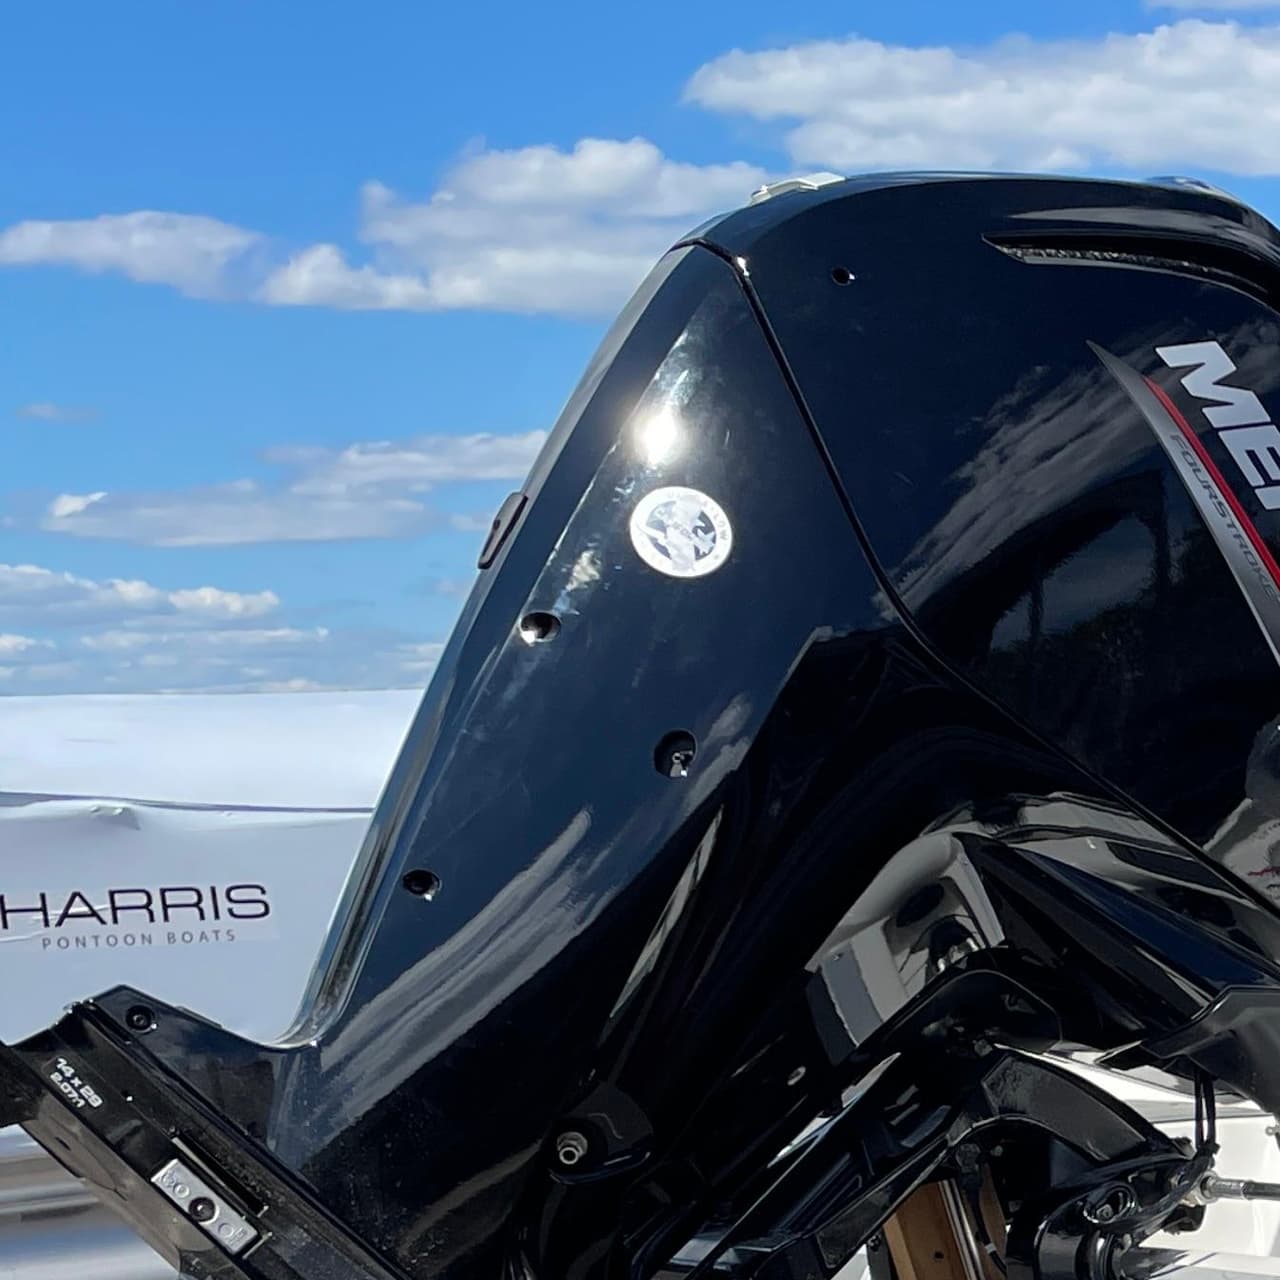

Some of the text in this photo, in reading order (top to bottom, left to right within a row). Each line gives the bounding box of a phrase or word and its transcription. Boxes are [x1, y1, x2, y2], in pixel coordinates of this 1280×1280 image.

[1170, 434, 1278, 600] FOURSTROKE
[0, 884, 271, 930] HARRIS
[42, 929, 236, 950] PONTOON BOATS
